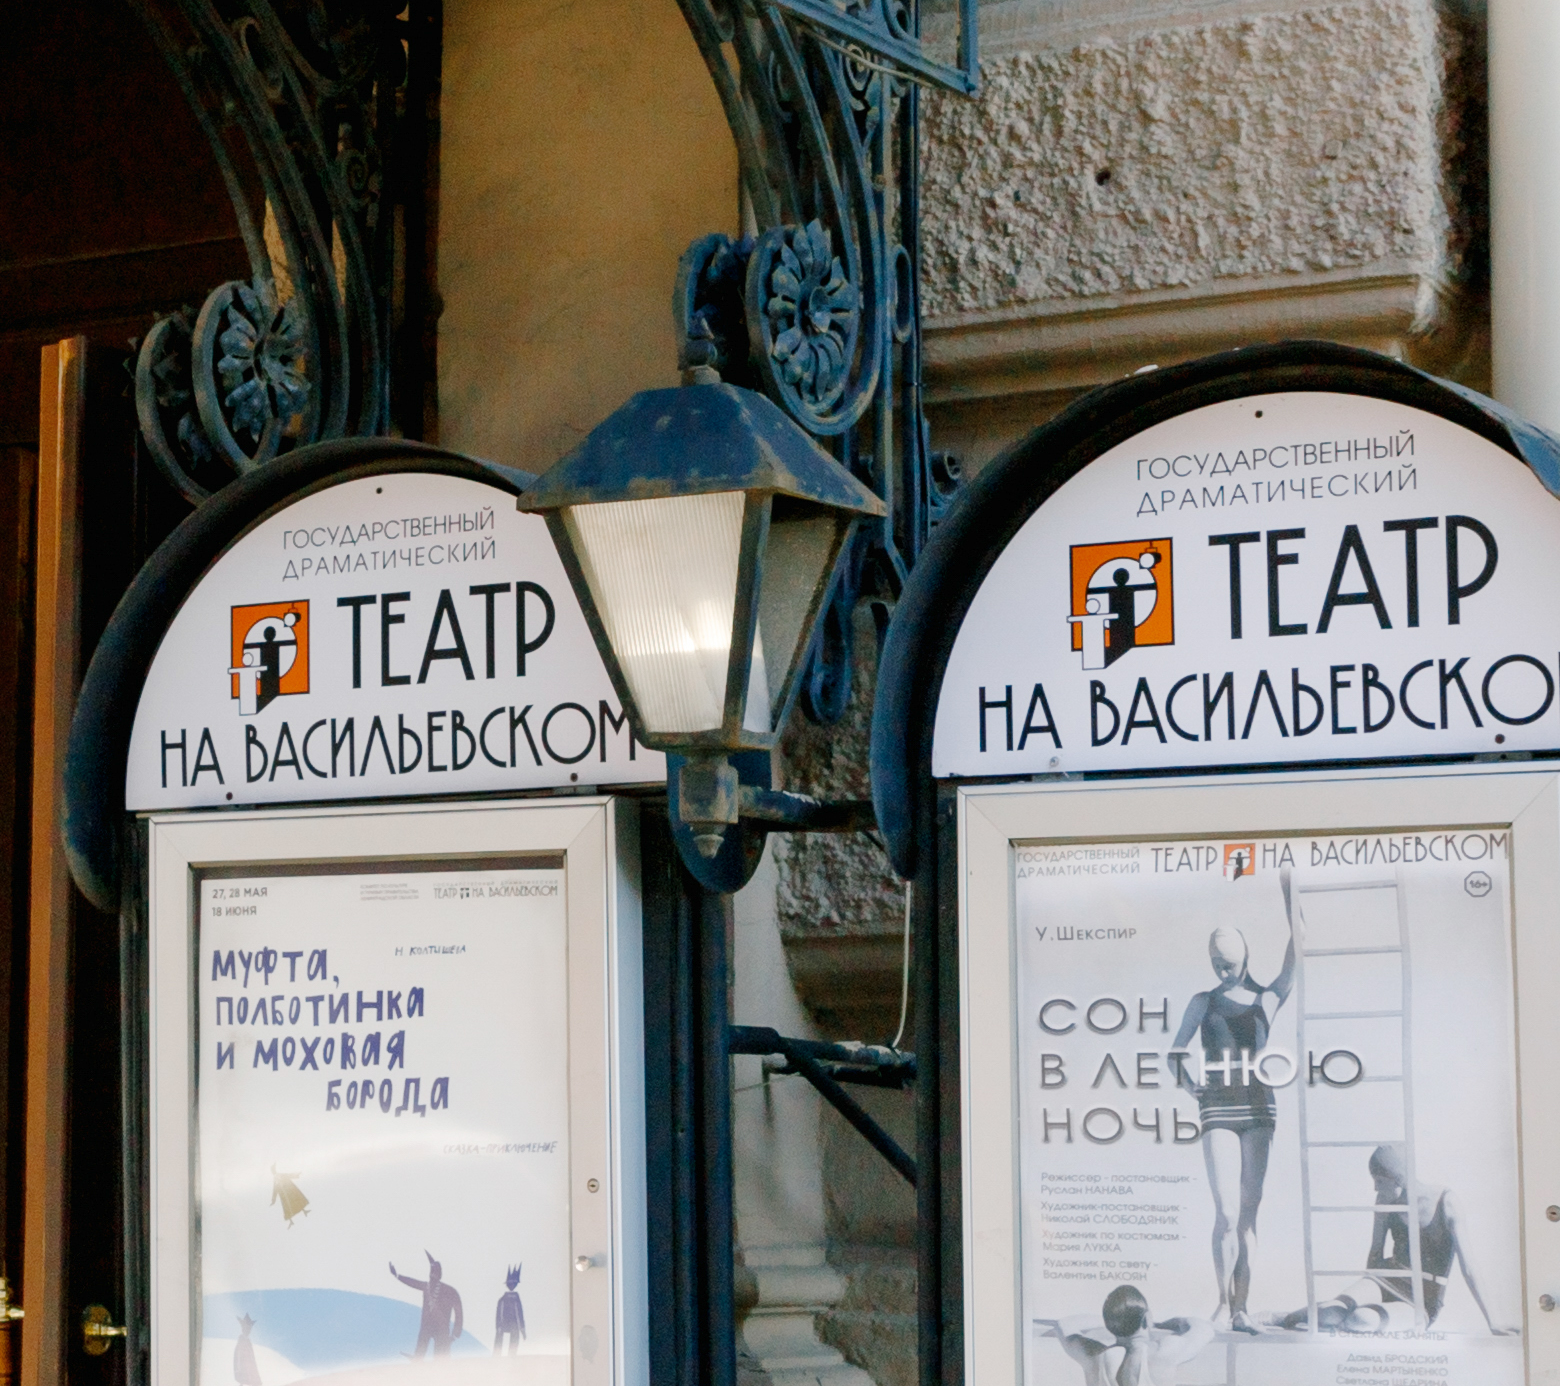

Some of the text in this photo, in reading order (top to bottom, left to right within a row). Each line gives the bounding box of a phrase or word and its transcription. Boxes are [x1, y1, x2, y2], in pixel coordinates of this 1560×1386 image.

[1136, 428, 1416, 482] ГОСУДАРСТВЕННЫЙ
[1136, 464, 1418, 518] ДРАМАТИЧЕСКИЙ
[282, 507, 495, 551] ГОСУДАРСТВЕННЫЙ
[282, 537, 497, 582] ДРАМАТИЧЕСКИЙ
[1209, 514, 1500, 640] ТЕАТР
[336, 581, 556, 689] ТЕАТР
[978, 684, 1062, 753] НА
[160, 699, 637, 788] НА ВАСИЛЬЕВСКОМ
[1017, 846, 1140, 863] ГОСУДАРСТВЕННЫЙ
[1151, 833, 1508, 873] ТЕАТР НА ВАСИЛЬЕВСКОМ
[1017, 862, 1140, 878] ДРАМАТИЧЕСКИЙ
[229, 888, 241, 898] 28
[243, 886, 268, 898] МАЯ
[434, 887, 457, 899] ТЕАТР
[472, 887, 484, 897] НА
[489, 885, 558, 897] ВАСИЛЬЕВСКОМ
[211, 906, 257, 917] 18 ИЮНЯ
[1037, 996, 1171, 1035] СОН
[1039, 1049, 1363, 1089] В ЛЕТНЮЮ
[1042, 1107, 1202, 1145] НОЧЬ
[1041, 1172, 1190, 1183] Режиссер постановщик
[1041, 1185, 1133, 1195] Руслан НАНАВА
[1041, 1214, 1179, 1225] Николай СЛОБОДЯНИК
[1042, 1230, 1097, 1241] Художник
[1118, 1232, 1179, 1241] костюмам
[1043, 1242, 1122, 1253] Мария ЛУККА
[1043, 1258, 1099, 1268] Художник
[1119, 1261, 1151, 1270] свету
[1043, 1270, 1147, 1281] Валентин БАКОЯН
[1385, 1354, 1449, 1364] БРОДСКИЙ
[1337, 1364, 1370, 1373] Елена
[1336, 1376, 1389, 1386] Светлана
